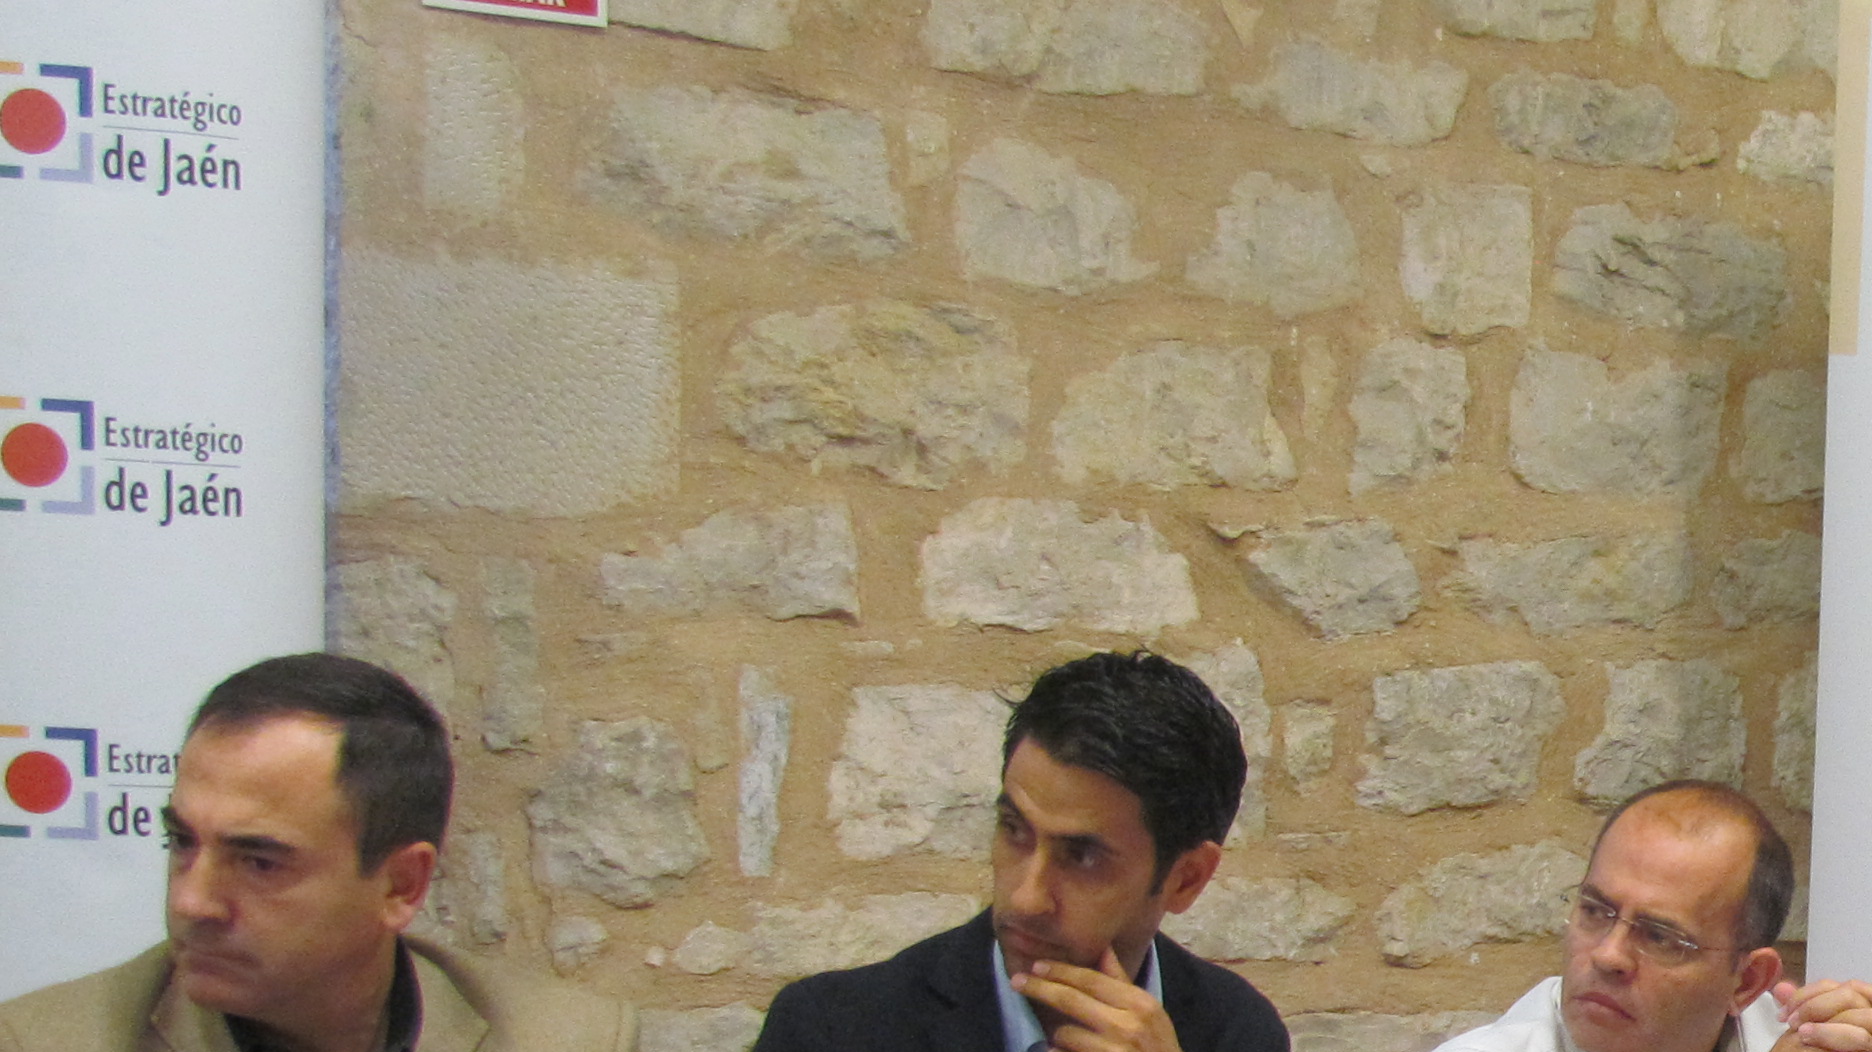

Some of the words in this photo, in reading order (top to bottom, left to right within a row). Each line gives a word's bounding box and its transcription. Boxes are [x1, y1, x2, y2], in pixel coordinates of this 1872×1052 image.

[103, 83, 241, 132] Estratégico
[103, 134, 146, 182] de
[157, 138, 241, 196] Jaén
[104, 416, 243, 462] Estratégico
[105, 466, 148, 512] de
[160, 470, 242, 526] Jaén
[108, 792, 151, 836] de
